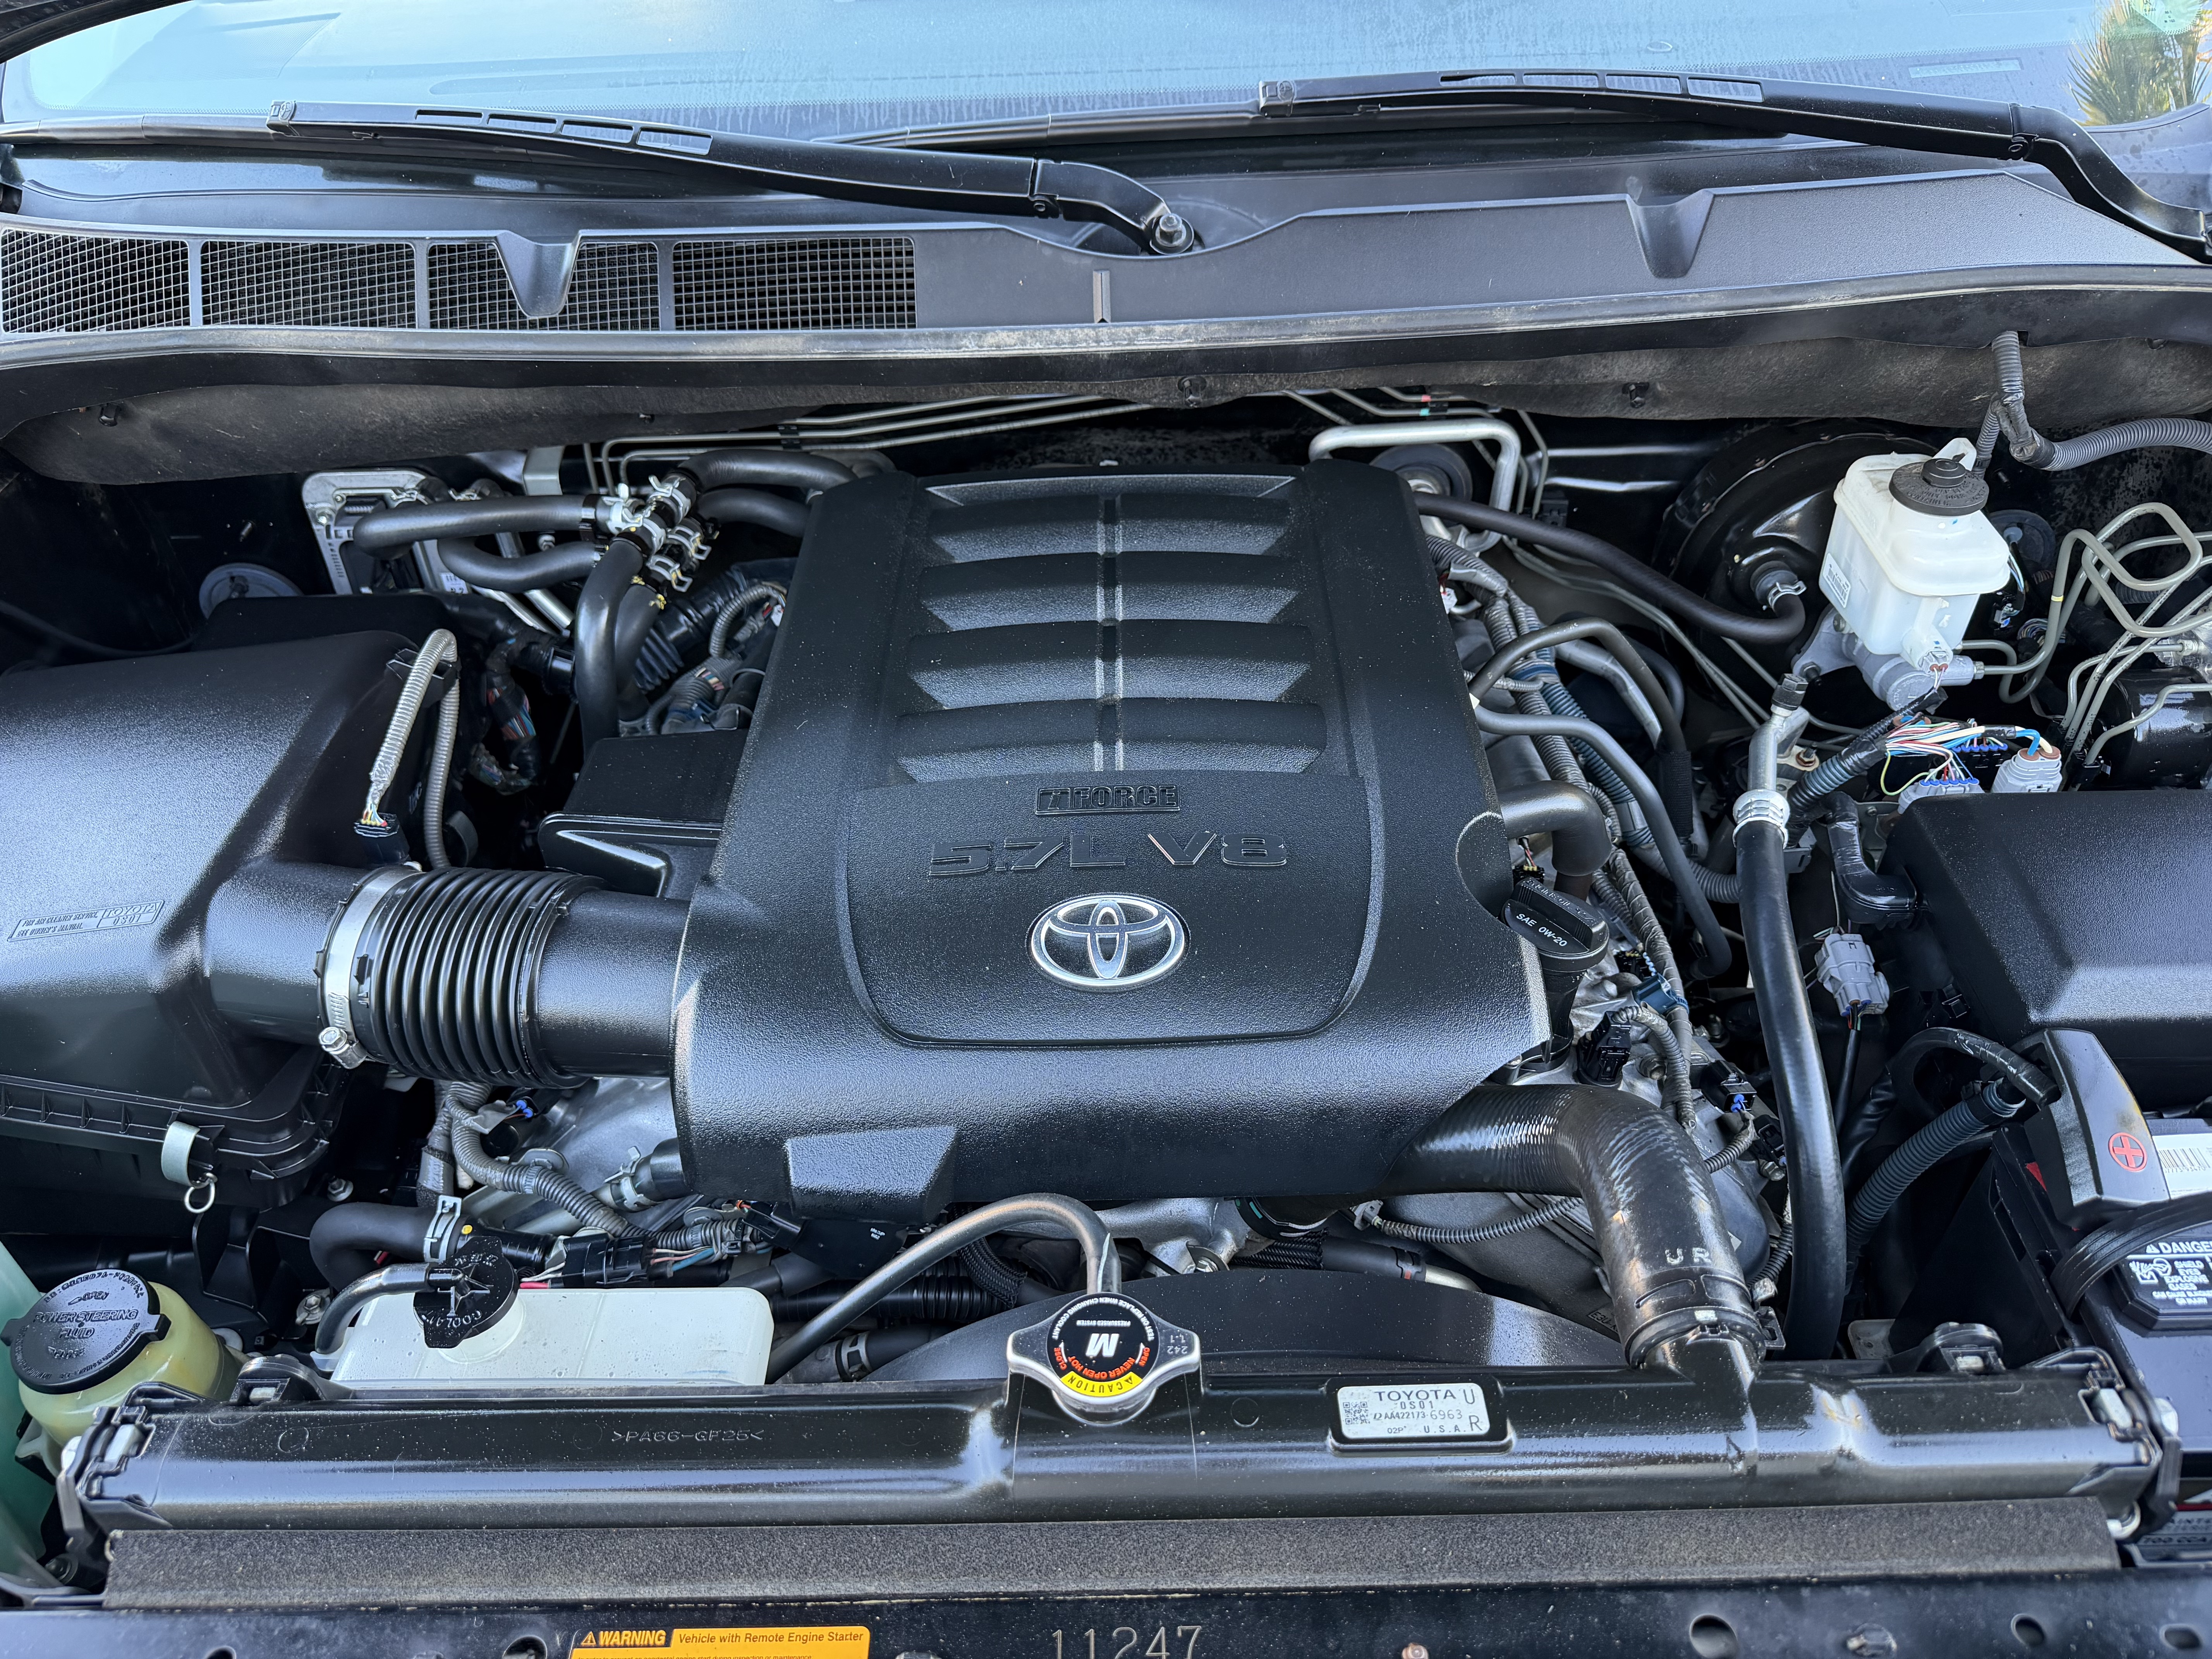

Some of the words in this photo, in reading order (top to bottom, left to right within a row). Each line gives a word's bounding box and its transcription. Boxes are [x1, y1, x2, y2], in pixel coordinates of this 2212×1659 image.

[929, 833, 1125, 875] 5.7L
[1148, 831, 1286, 866] V8
[105, 903, 156, 917] TOYOTA
[1516, 914, 1537, 927] SAE
[1538, 927, 1568, 946] 0W-20
[2174, 1261, 2204, 1269] SHIELD
[2164, 1274, 2209, 1283] EXPLOSIVE
[82, 1291, 109, 1301] OPEN
[1067, 1298, 1099, 1315] CHANGING
[1118, 1299, 1144, 1320] REPLACE
[33, 1312, 77, 1323] POWER
[75, 1309, 139, 1322] STEERING
[1140, 1318, 1150, 1327] OR
[60, 1328, 95, 1339] FLUID
[1052, 1313, 1070, 1340] COOLANT
[1145, 1326, 1155, 1341] TEST
[1139, 1347, 1150, 1367] OPEN
[1167, 1346, 1188, 1354] 242
[1054, 1347, 1067, 1370] CLOSE
[1068, 1356, 1084, 1372] HOT
[1083, 1368, 1108, 1379] OPEN
[1108, 1357, 1135, 1377] NEVER
[1068, 1375, 1123, 1393] CAUTION
[1374, 1389, 1456, 1401] TOYOTA
[1463, 1388, 1475, 1405] U
[1469, 1415, 1483, 1432] R
[599, 1630, 666, 1645] WARNING
[679, 1633, 716, 1643] Vehicle
[719, 1633, 740, 1643] with
[744, 1632, 784, 1642] Remote
[788, 1632, 824, 1644] Engine
[827, 1631, 864, 1641] Starter
[1051, 1625, 1202, 1659] 11247
